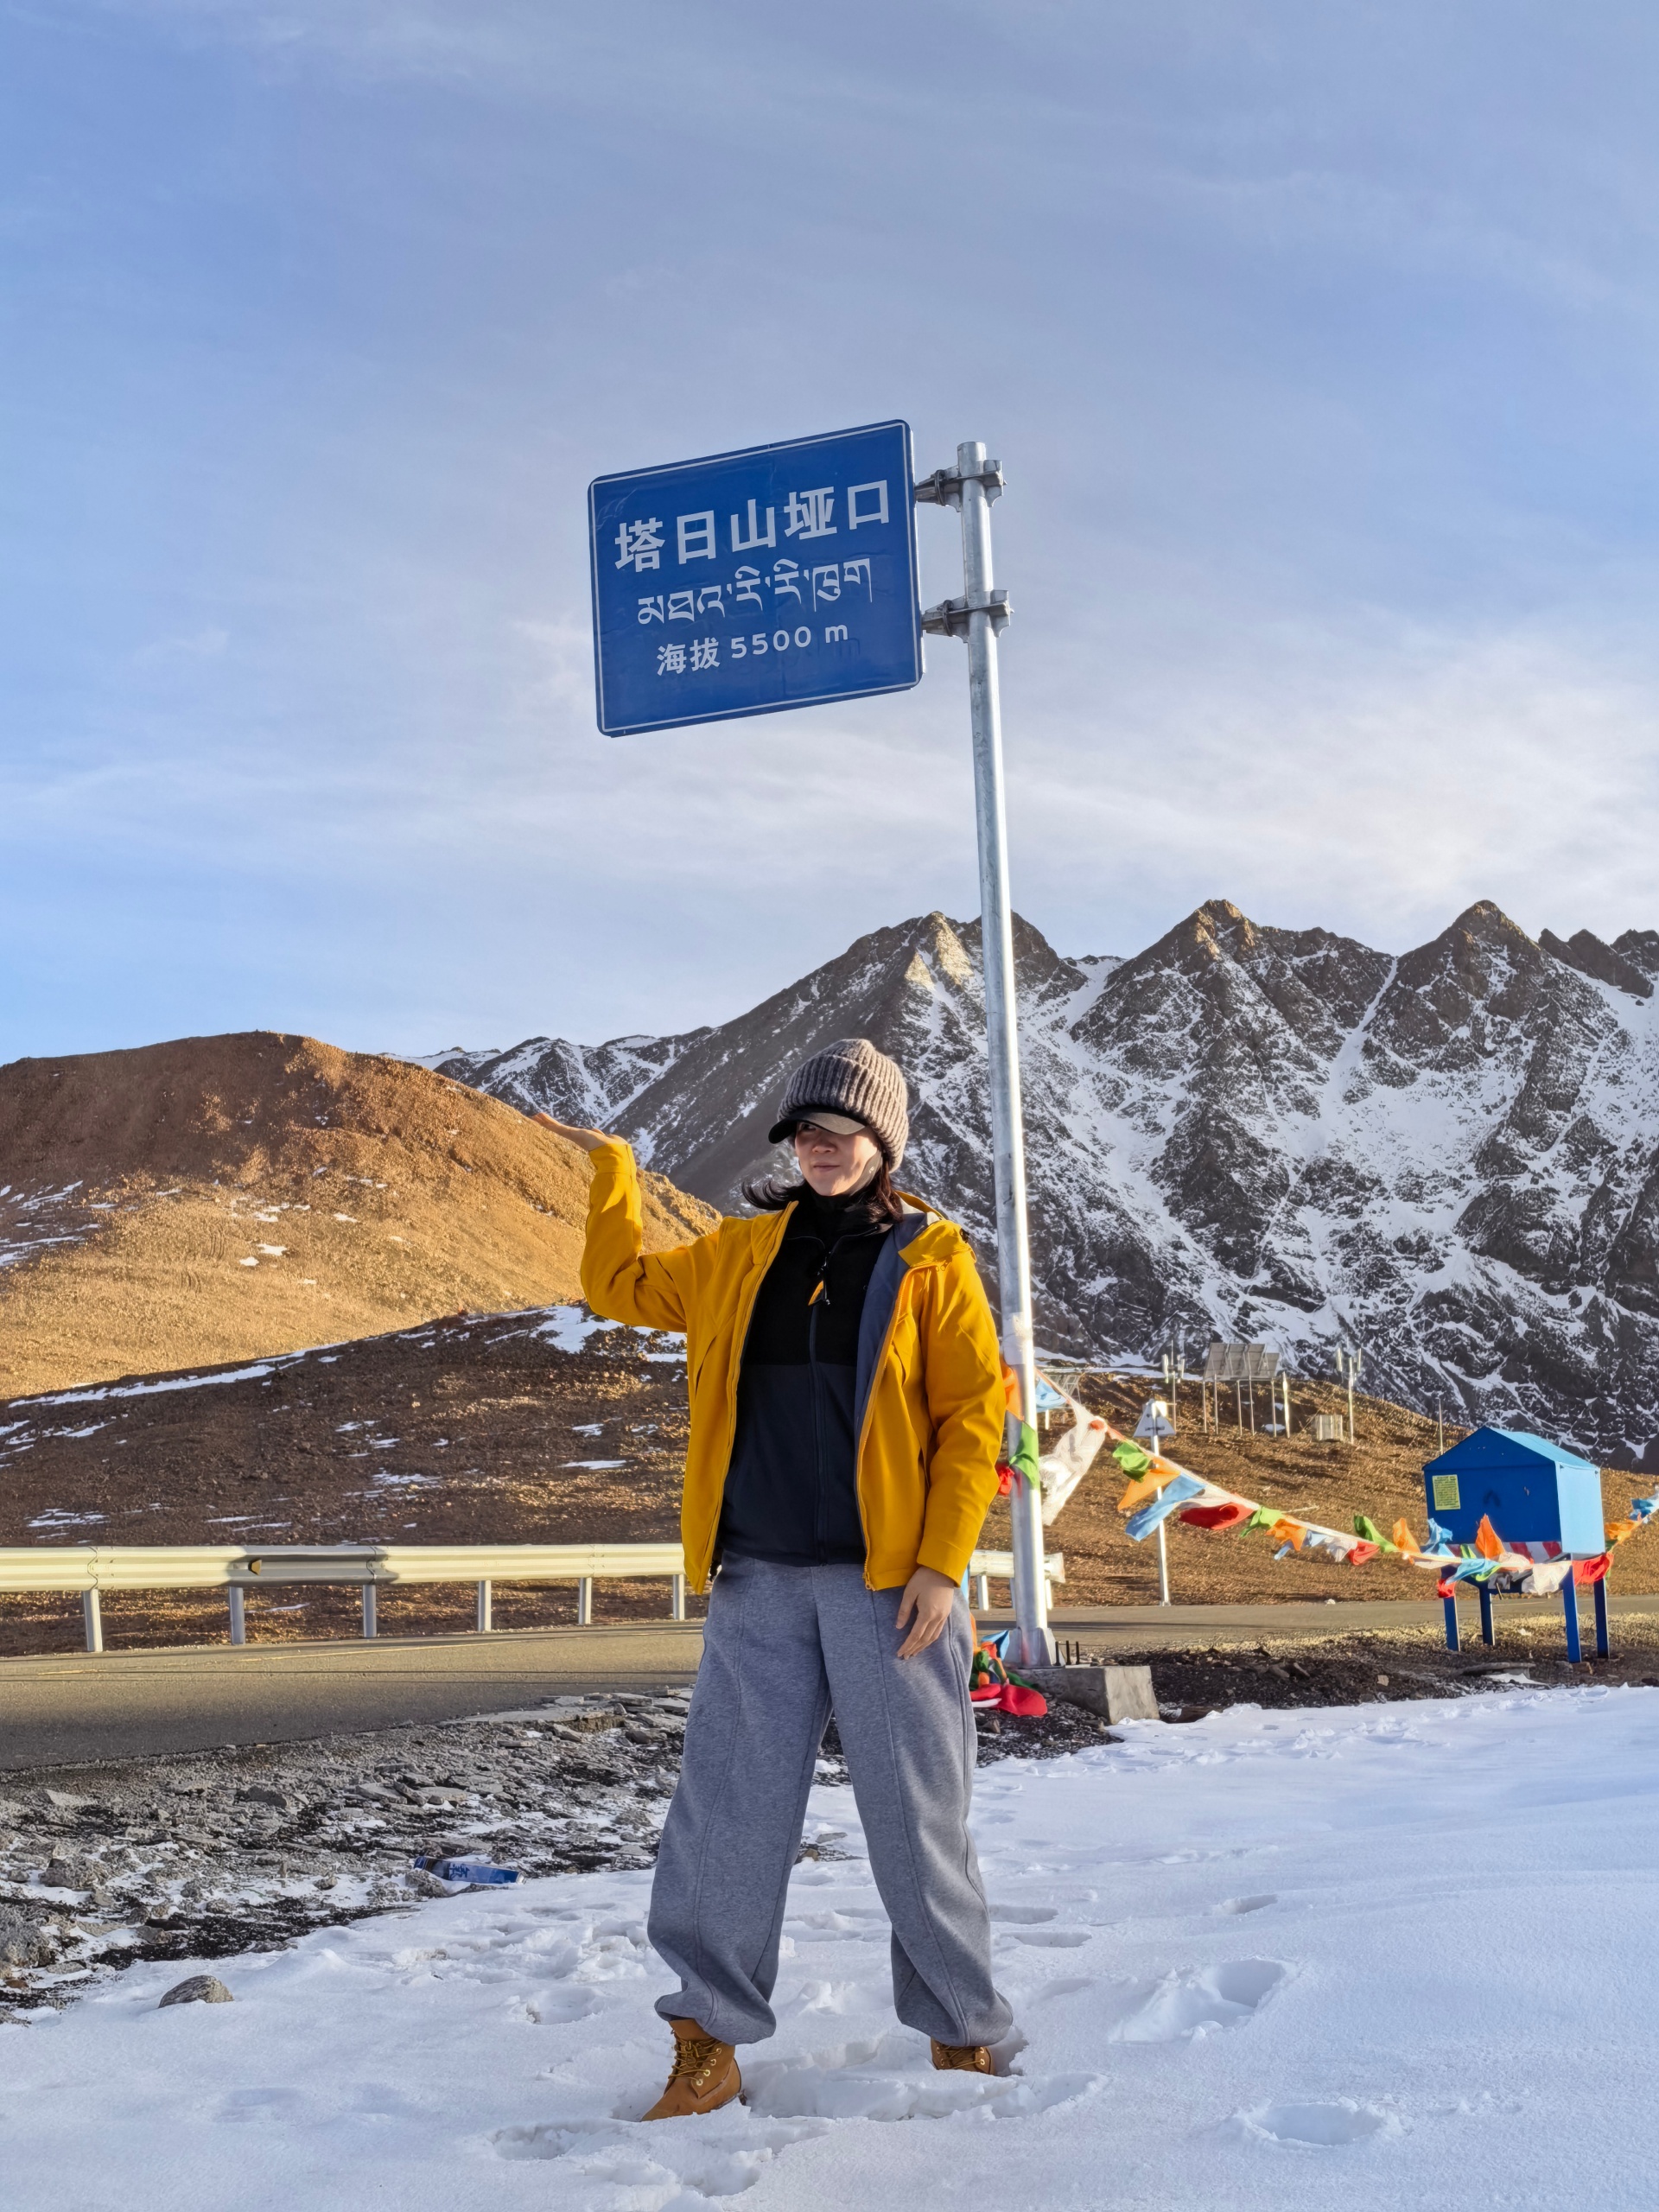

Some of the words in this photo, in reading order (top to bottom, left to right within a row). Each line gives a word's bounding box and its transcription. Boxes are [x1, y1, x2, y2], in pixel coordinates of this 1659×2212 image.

[614, 480, 889, 573] 塔日山垭口
[657, 637, 721, 676] 海拔
[730, 626, 812, 659] 5500
[824, 624, 849, 644] m
